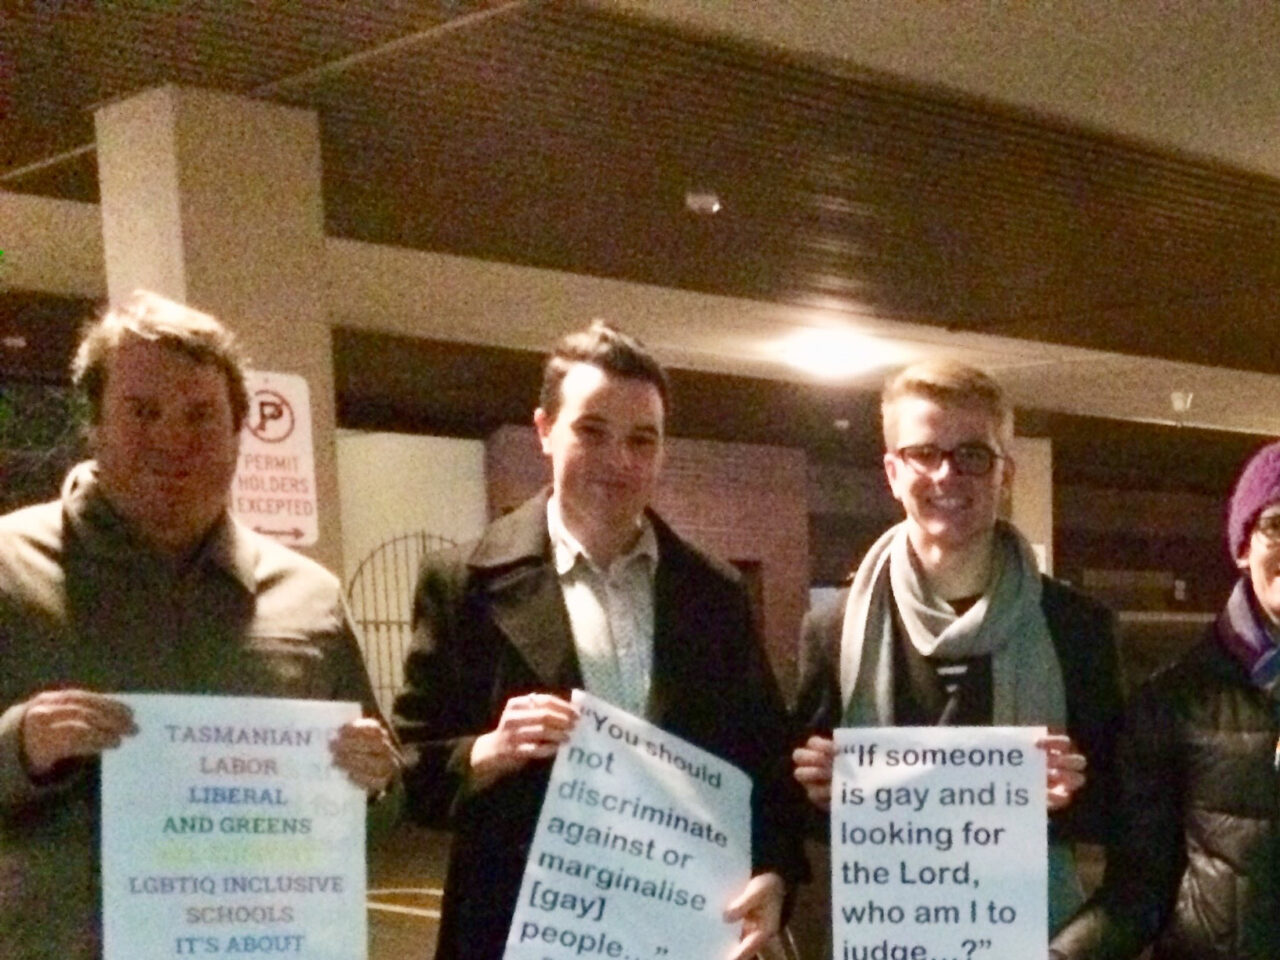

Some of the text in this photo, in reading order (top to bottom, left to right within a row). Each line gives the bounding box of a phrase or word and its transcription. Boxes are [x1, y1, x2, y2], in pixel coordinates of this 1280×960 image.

[259, 401, 283, 431] P
[245, 455, 298, 471] PERMIT
[238, 477, 308, 493] HOLDERS
[238, 499, 313, 515] EXCEPTED
[165, 725, 312, 746] TASMANIAN
[582, 706, 722, 789] “You should
[843, 745, 1023, 766] “If someone
[200, 757, 277, 775] LABOR
[568, 747, 615, 773] not
[189, 787, 287, 805] LIBERAL
[842, 783, 1029, 811] is gay and is
[558, 779, 727, 847] discriminate
[163, 817, 312, 834] AND GREENS
[841, 822, 1005, 851] looking for
[547, 815, 693, 869] against or
[129, 877, 343, 894] LGBTIQ INCLUSIVE
[538, 853, 707, 910] marginalise
[842, 862, 979, 888] the Lord,
[529, 881, 606, 921] [gay]
[842, 900, 1016, 923] who am I to
[186, 906, 294, 924] SCHOOLS
[225, 935, 304, 953] ABOUT
